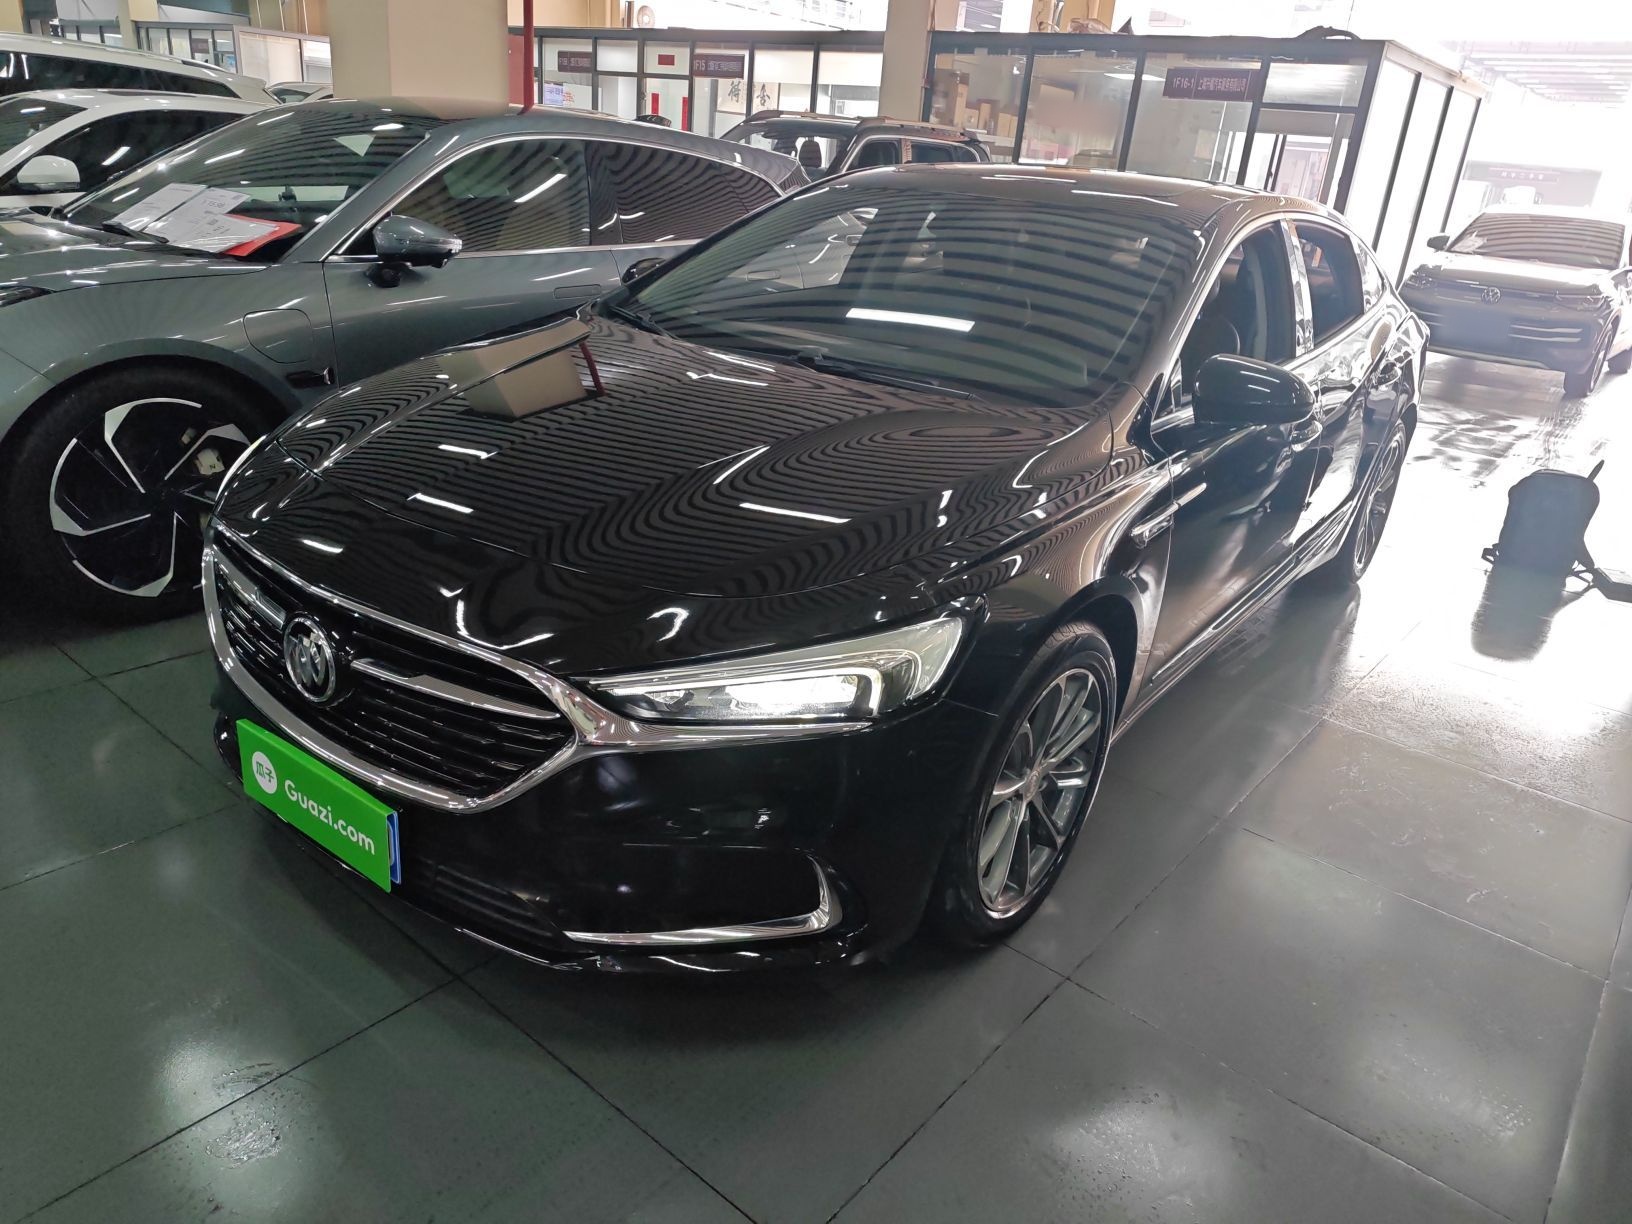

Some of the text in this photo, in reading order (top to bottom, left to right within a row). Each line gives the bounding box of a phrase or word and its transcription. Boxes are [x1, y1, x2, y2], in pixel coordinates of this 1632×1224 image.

[1173, 77, 1195, 89] 1F16-1
[256, 761, 274, 783] 瓜子
[285, 780, 374, 855] Guazi.com
